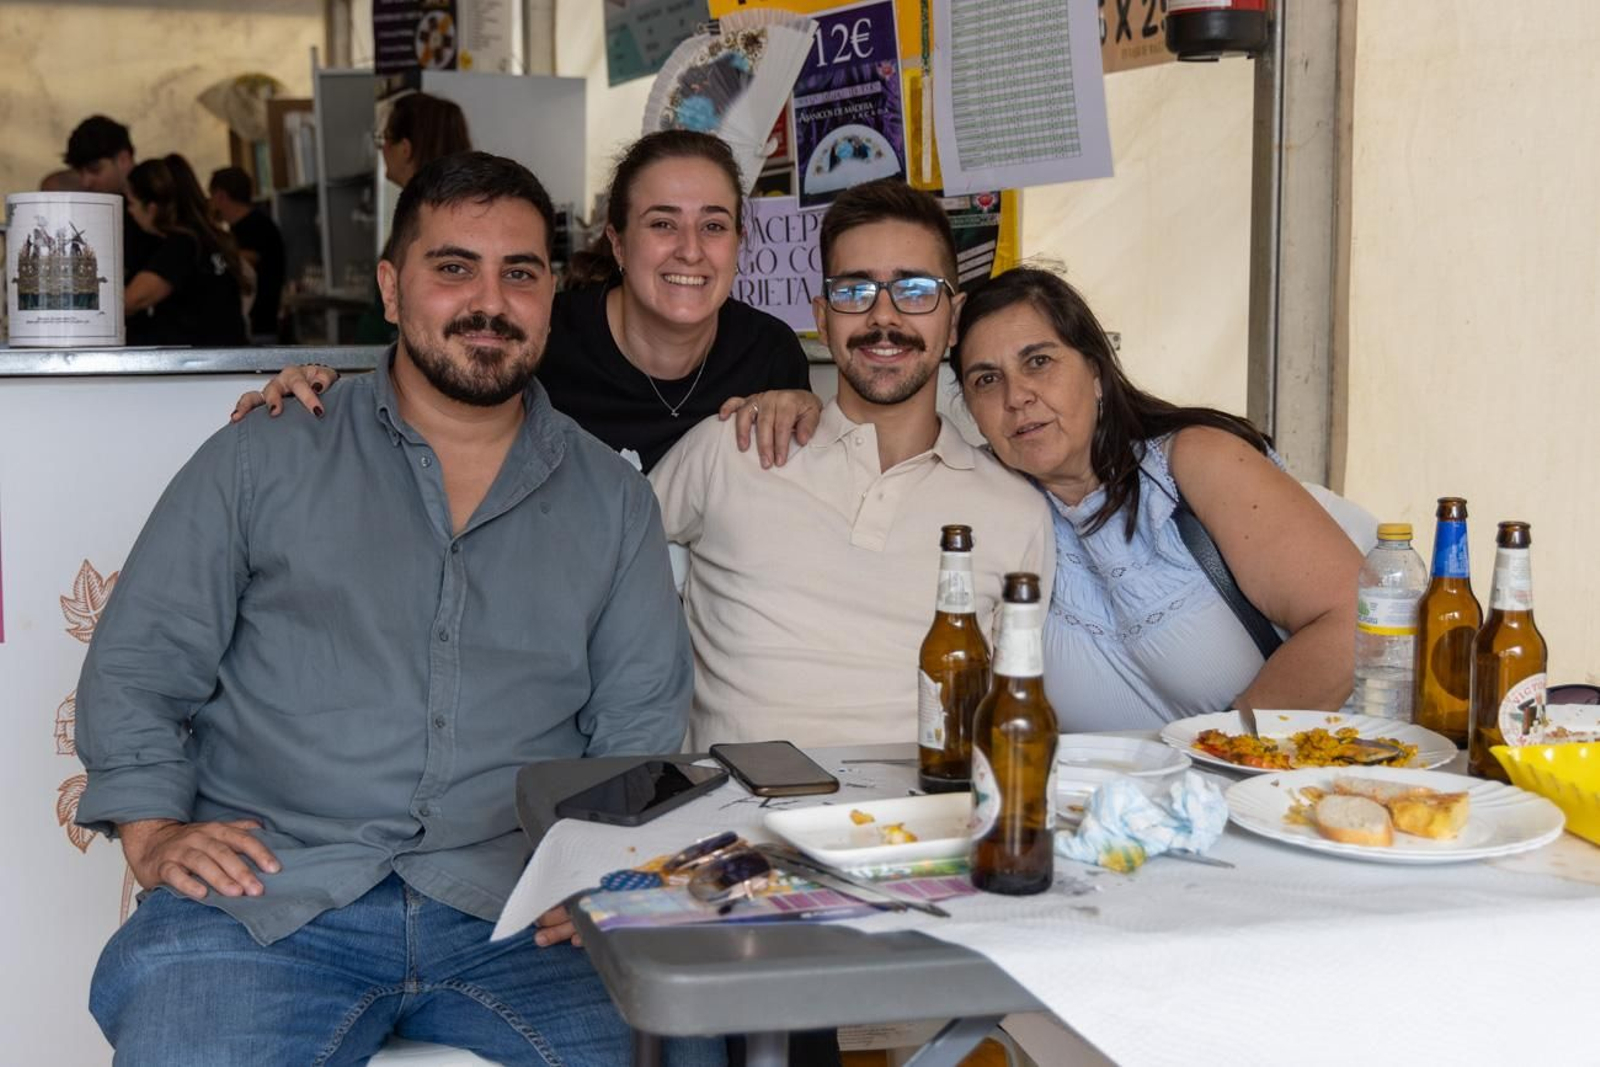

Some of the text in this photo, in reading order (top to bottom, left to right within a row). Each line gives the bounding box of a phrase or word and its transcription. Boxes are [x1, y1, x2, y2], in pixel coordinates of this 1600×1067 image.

[815, 18, 874, 67] 12€
[749, 213, 823, 244] ACEP
[730, 277, 812, 306] RJETA
